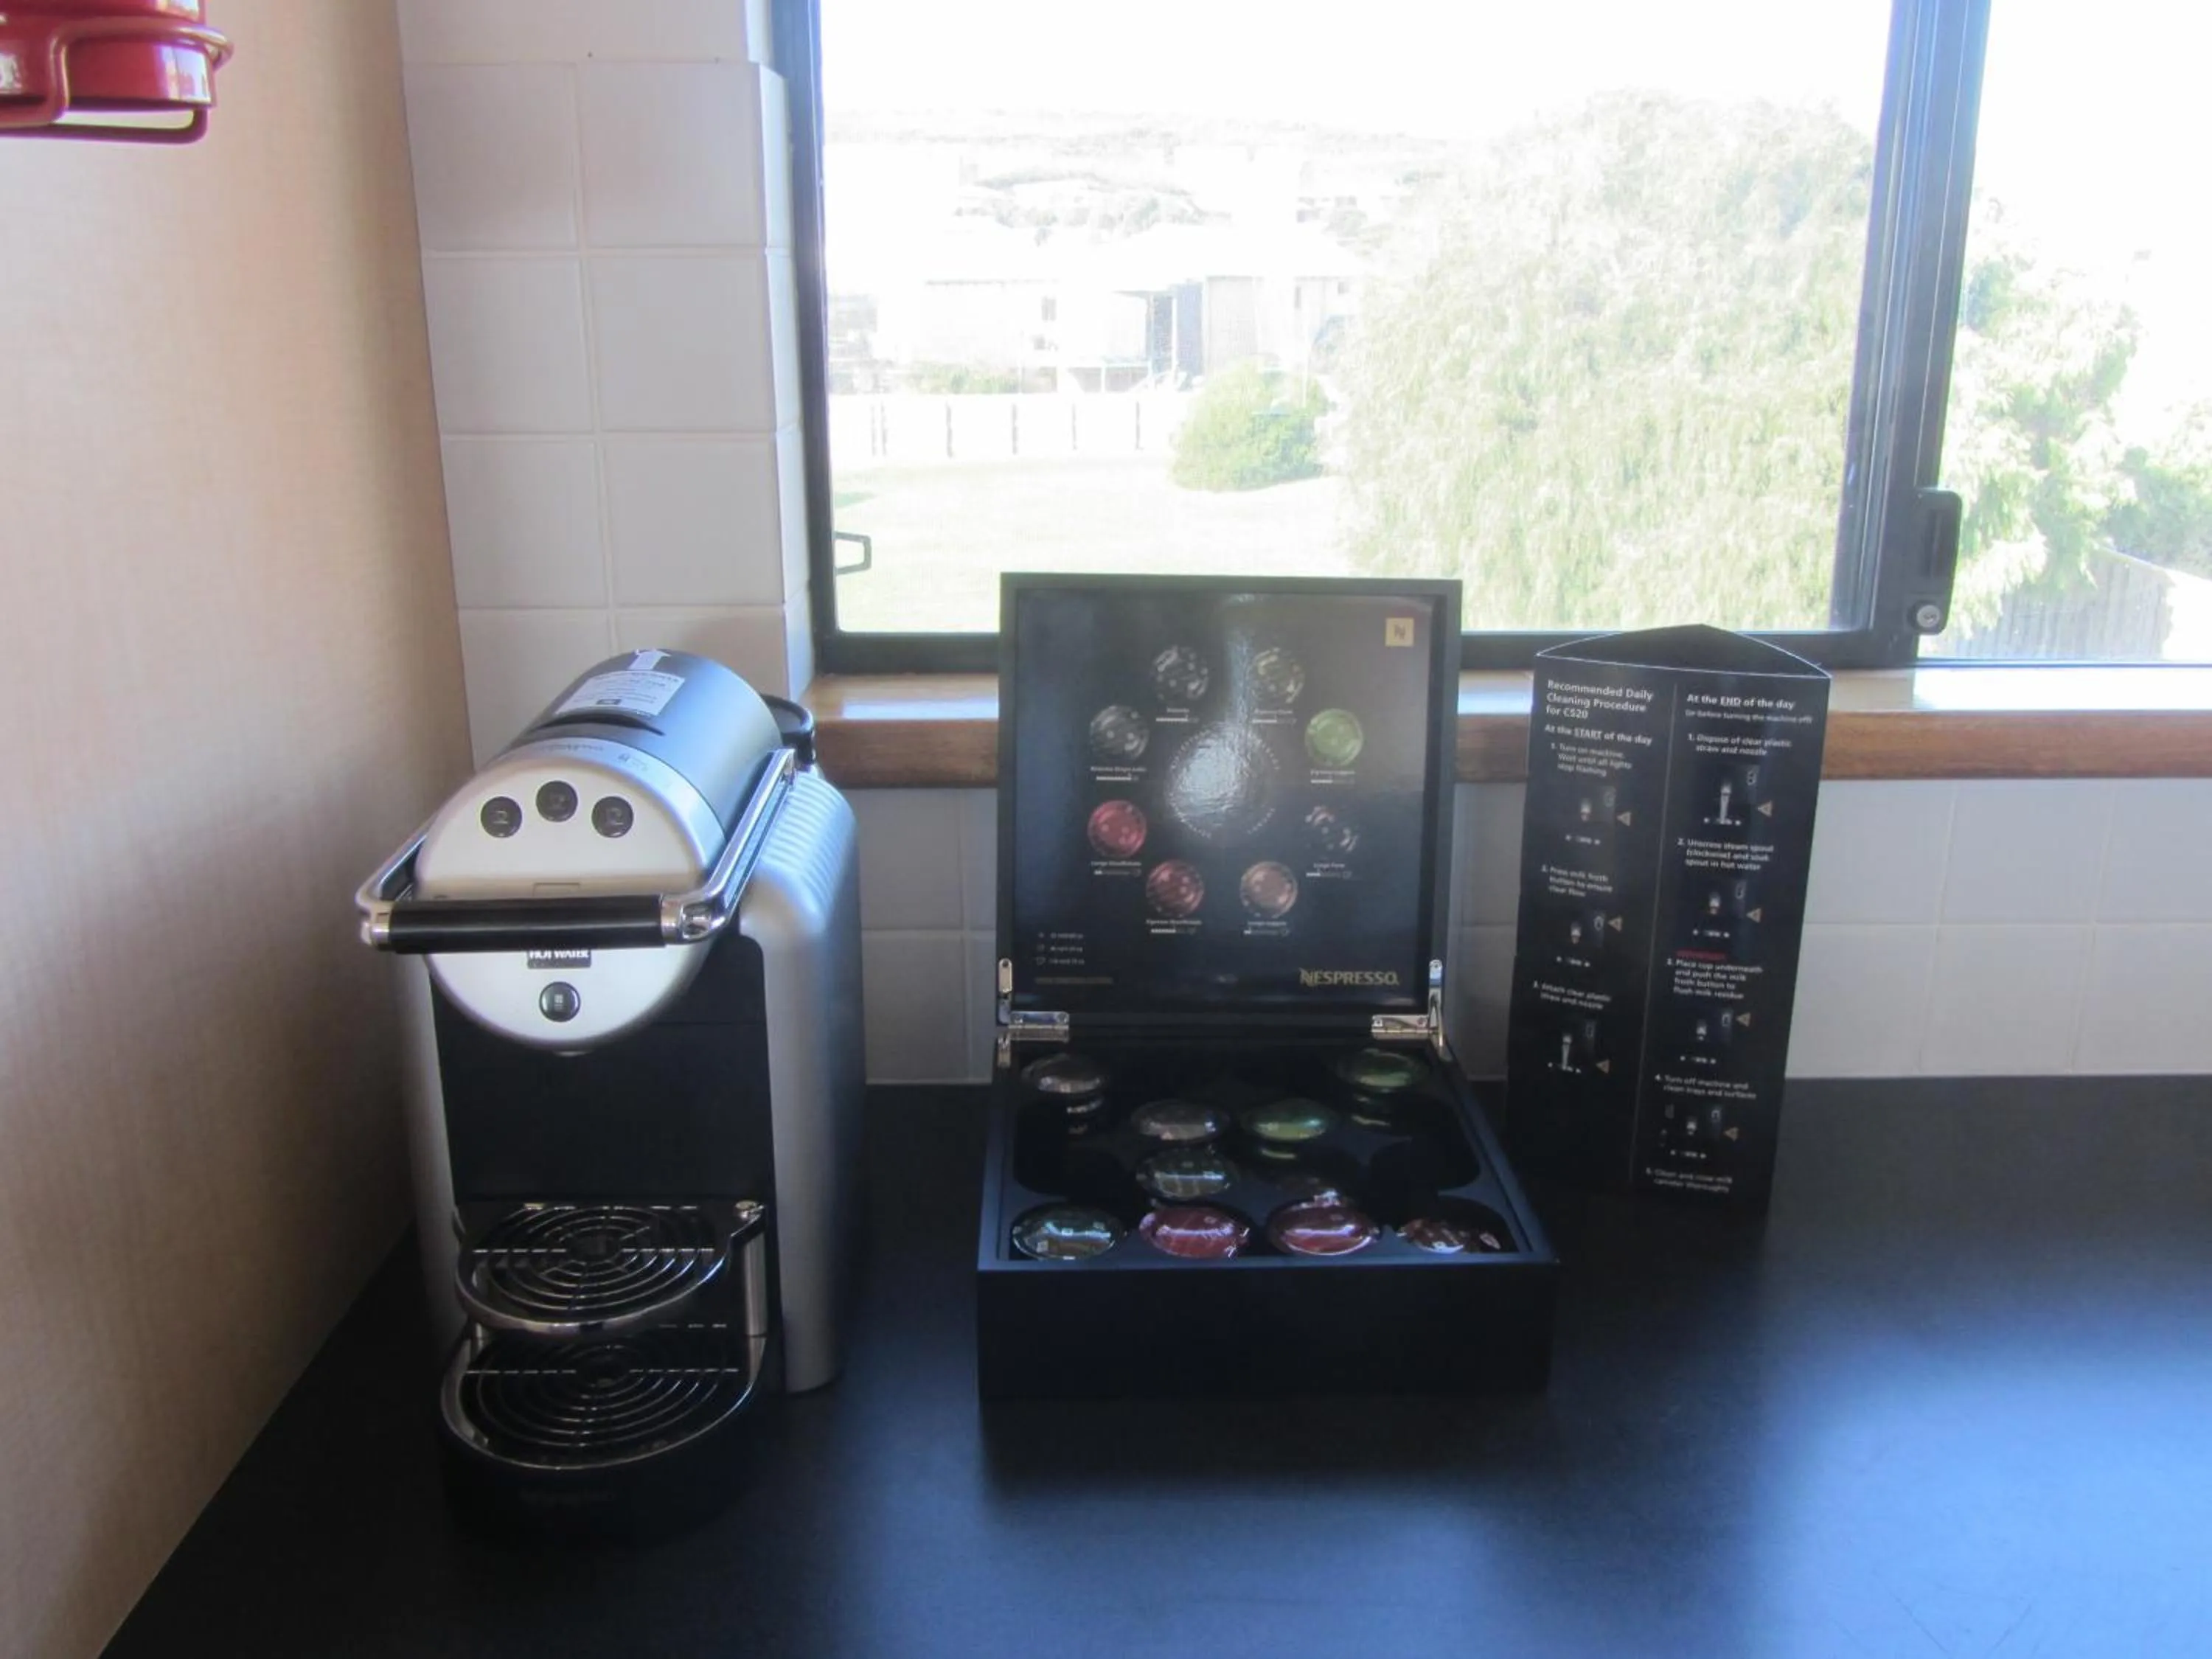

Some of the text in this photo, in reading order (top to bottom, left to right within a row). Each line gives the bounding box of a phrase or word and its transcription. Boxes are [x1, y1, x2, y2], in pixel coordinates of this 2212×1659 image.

[1547, 678, 1654, 703] Recommended Daily
[1545, 704, 1589, 720] for CS20
[1546, 692, 1647, 712] Cleaning Procedure
[1686, 693, 1796, 711] At the END of the day
[1545, 723, 1653, 747] At the START of the day
[1696, 734, 1729, 745] Dispose
[1731, 736, 1741, 745] of
[1742, 737, 1762, 746] clear
[1298, 967, 1400, 987] NESPRESSO
